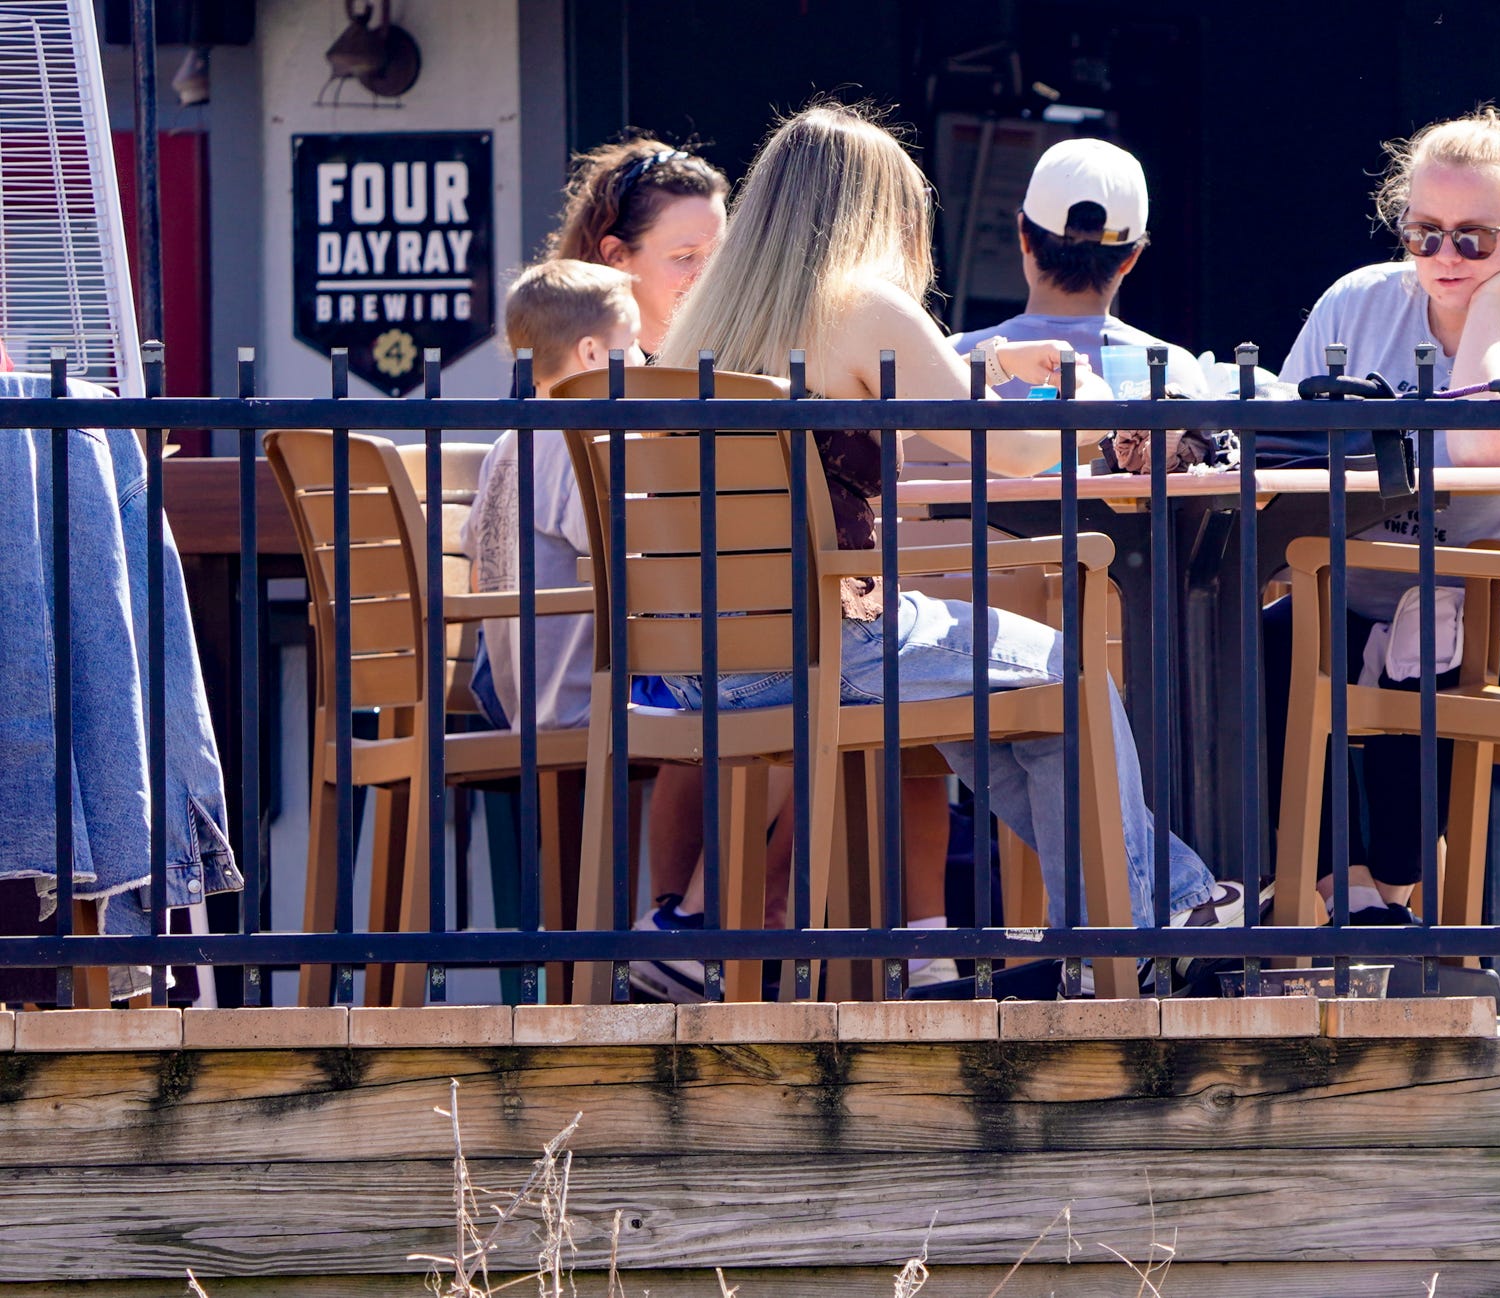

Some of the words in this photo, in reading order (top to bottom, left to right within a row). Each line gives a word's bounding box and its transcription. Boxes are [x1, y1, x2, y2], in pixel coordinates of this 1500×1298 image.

[316, 160, 470, 226] FOUR
[316, 231, 392, 275] DAY
[397, 230, 473, 274] RAY
[315, 293, 472, 322] BREWING
[1384, 519, 1409, 535] THE
[1411, 524, 1447, 542] PE
